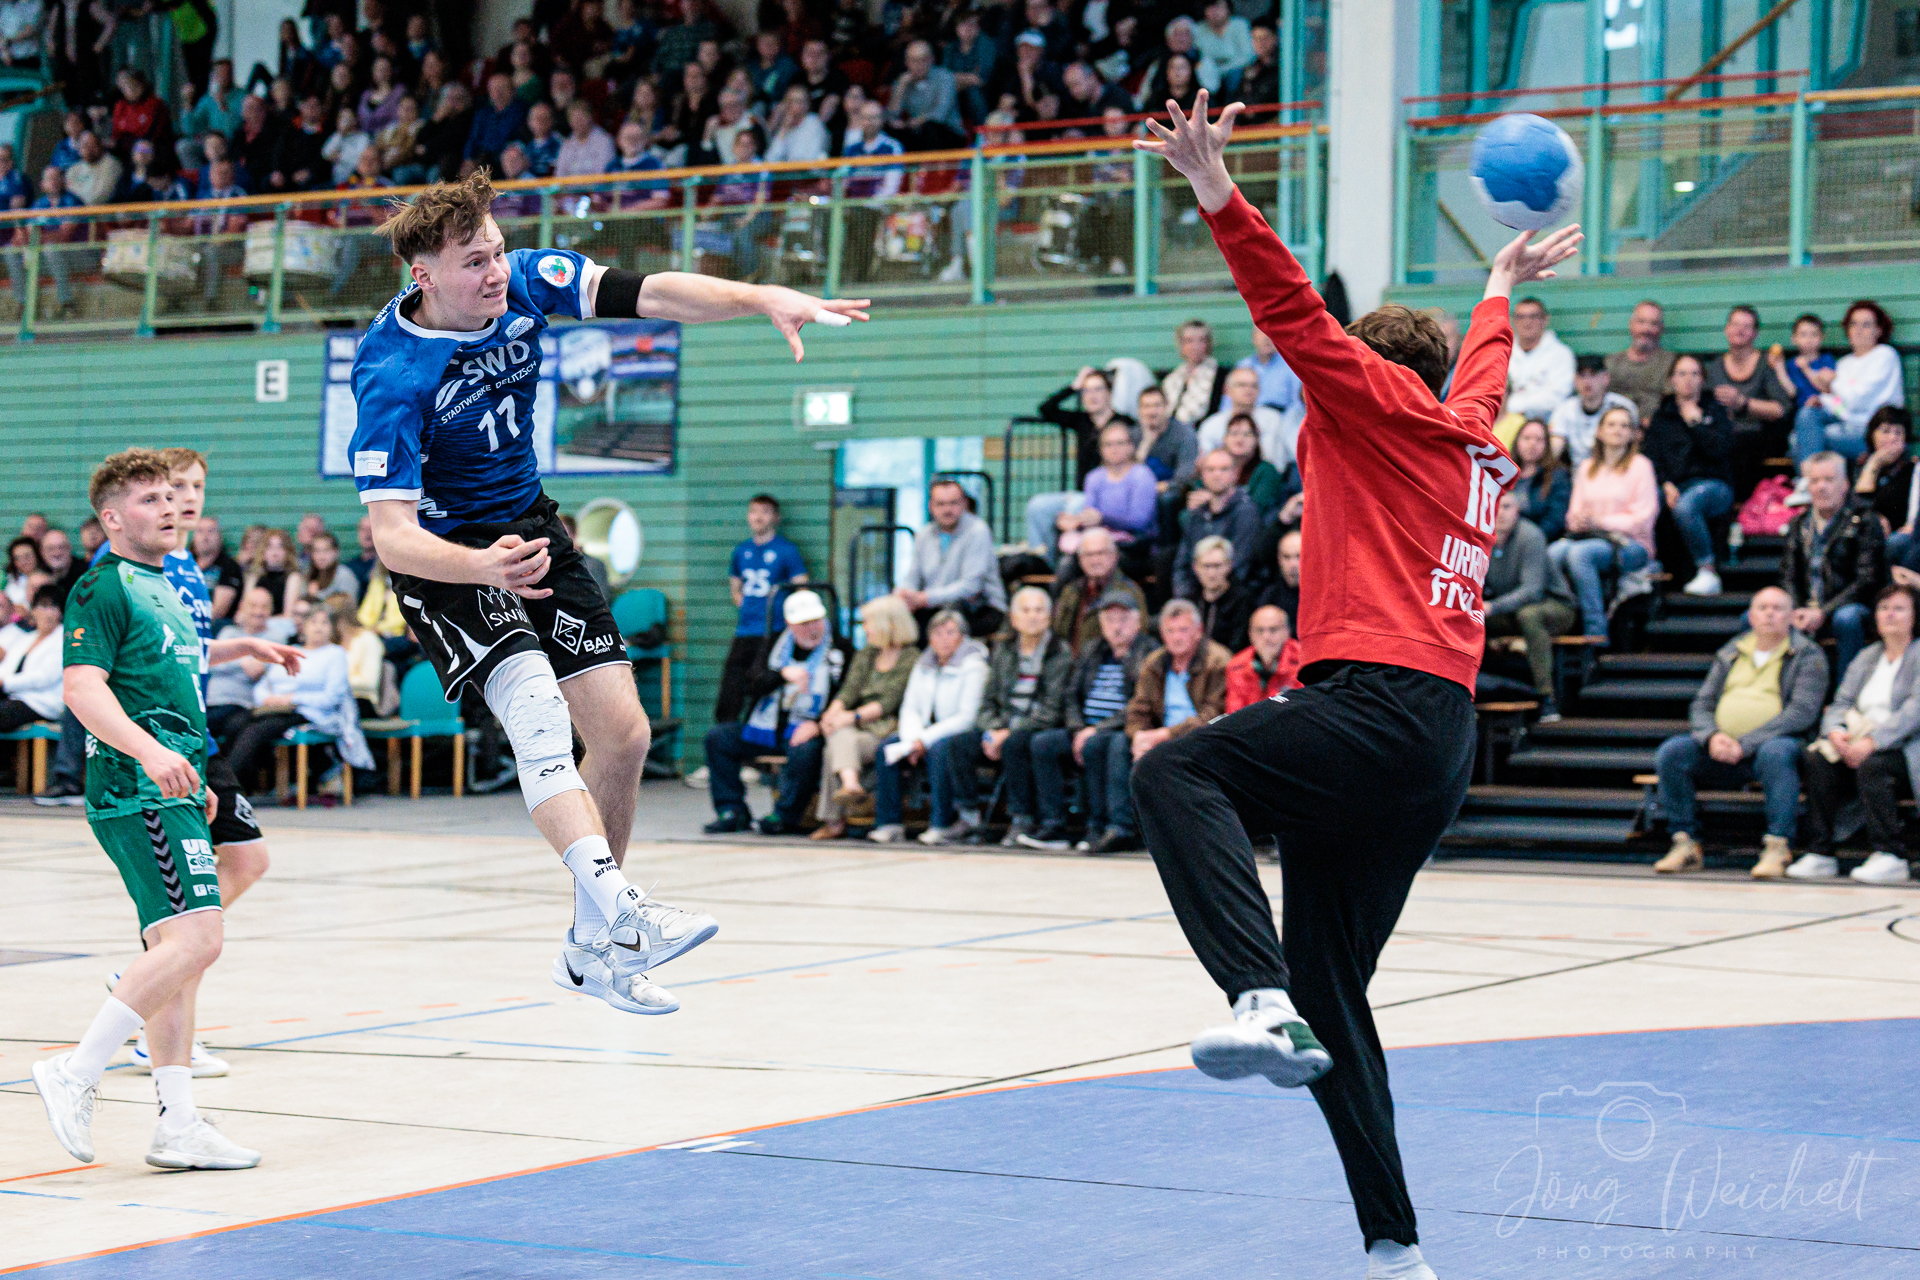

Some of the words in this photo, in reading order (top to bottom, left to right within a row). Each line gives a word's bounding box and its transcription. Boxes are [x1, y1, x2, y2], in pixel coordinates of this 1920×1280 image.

[264, 366, 281, 396] E
[462, 340, 531, 386] SWD
[441, 384, 492, 425] STADTWERKE
[495, 360, 537, 389] DELITZSCH
[477, 394, 521, 453] 11
[582, 633, 614, 653] BAU
